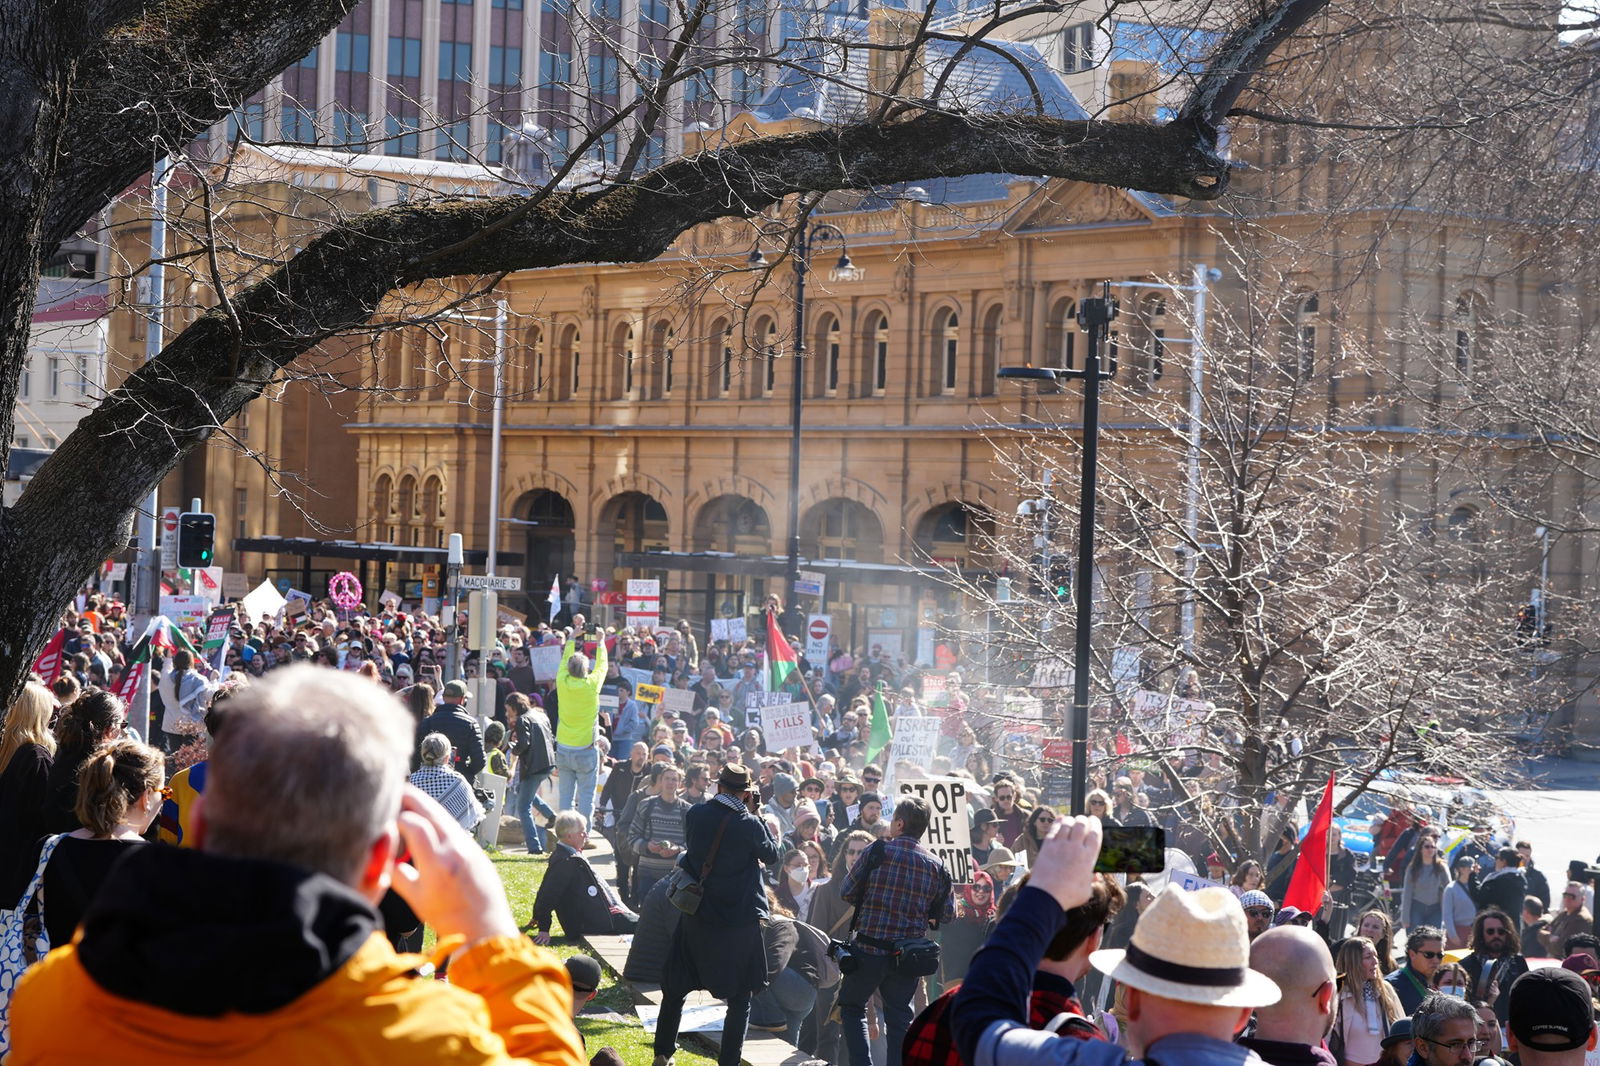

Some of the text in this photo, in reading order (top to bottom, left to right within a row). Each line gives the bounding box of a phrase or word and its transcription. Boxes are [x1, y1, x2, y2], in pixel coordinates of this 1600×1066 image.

[464, 577, 507, 589] MACQUARIE
[211, 615, 231, 624] CEASE
[209, 623, 229, 632] FIRE
[206, 632, 224, 640] NOW
[773, 715, 805, 729] KILLS
[896, 718, 940, 732] ISRAEL
[901, 734, 915, 743] out
